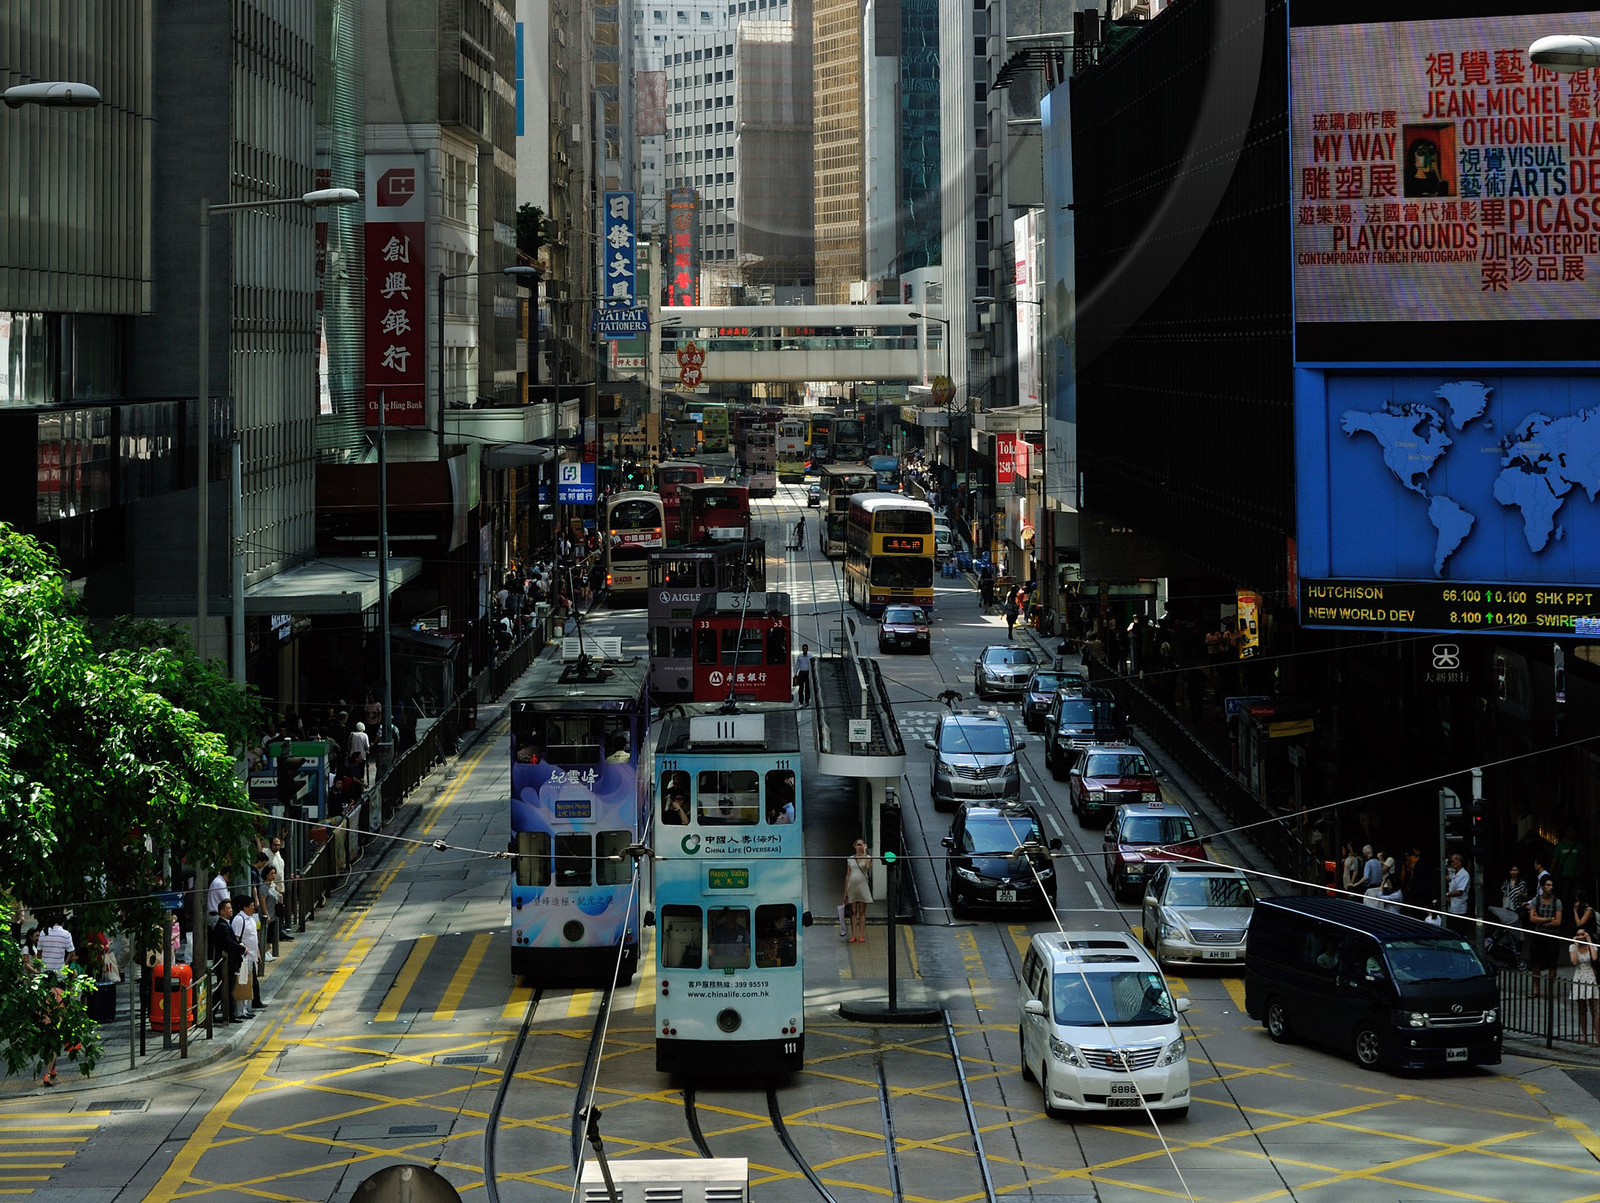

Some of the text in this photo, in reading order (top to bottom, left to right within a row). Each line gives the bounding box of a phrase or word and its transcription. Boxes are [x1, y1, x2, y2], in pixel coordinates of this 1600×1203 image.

[1423, 85, 1566, 119] JEAN-MICHEL
[1312, 110, 1398, 132] 琉璃創作展
[1462, 115, 1567, 146] OTHONIEL
[1313, 132, 1398, 163] MY WAY
[1507, 145, 1567, 168] VISUAL
[1301, 164, 1398, 200] 雕塑展
[1508, 167, 1567, 197] ARTS
[1332, 221, 1479, 251] PLAYGROUNDS
[606, 194, 634, 307] 日發文具
[1298, 249, 1479, 265] CONTEMPORARY FRENCH PHOTOGRAPHY
[1510, 256, 1585, 282] 珍品展
[379, 235, 413, 373] 創興銀行
[621, 309, 644, 321] FAT
[369, 400, 423, 411] Chg Hing Bank
[559, 492, 594, 501] 富邦銀行
[671, 593, 702, 602] AIGLE
[1308, 585, 1594, 606] HUTCHISON 66.100 0.100 SHK PPT
[699, 620, 710, 629] 33
[1308, 606, 1337, 620] NEW
[1339, 607, 1387, 622] WORLD
[1389, 609, 1416, 623] DEV
[1449, 612, 1482, 624] 8.100
[1495, 612, 1528, 625] 0.120
[1535, 613, 1577, 627] SWIRE
[1424, 671, 1471, 684] 大新銀行
[520, 702, 526, 712] 7
[618, 701, 625, 710] 7
[716, 721, 735, 739] 111
[663, 760, 678, 770] 111
[775, 759, 790, 770] 111
[705, 845, 782, 855] CHINA LIFE (OVERSEAS)
[623, 949, 630, 958] 7
[687, 990, 770, 998] www.chinalife.com.hk
[784, 1042, 797, 1054] 111
